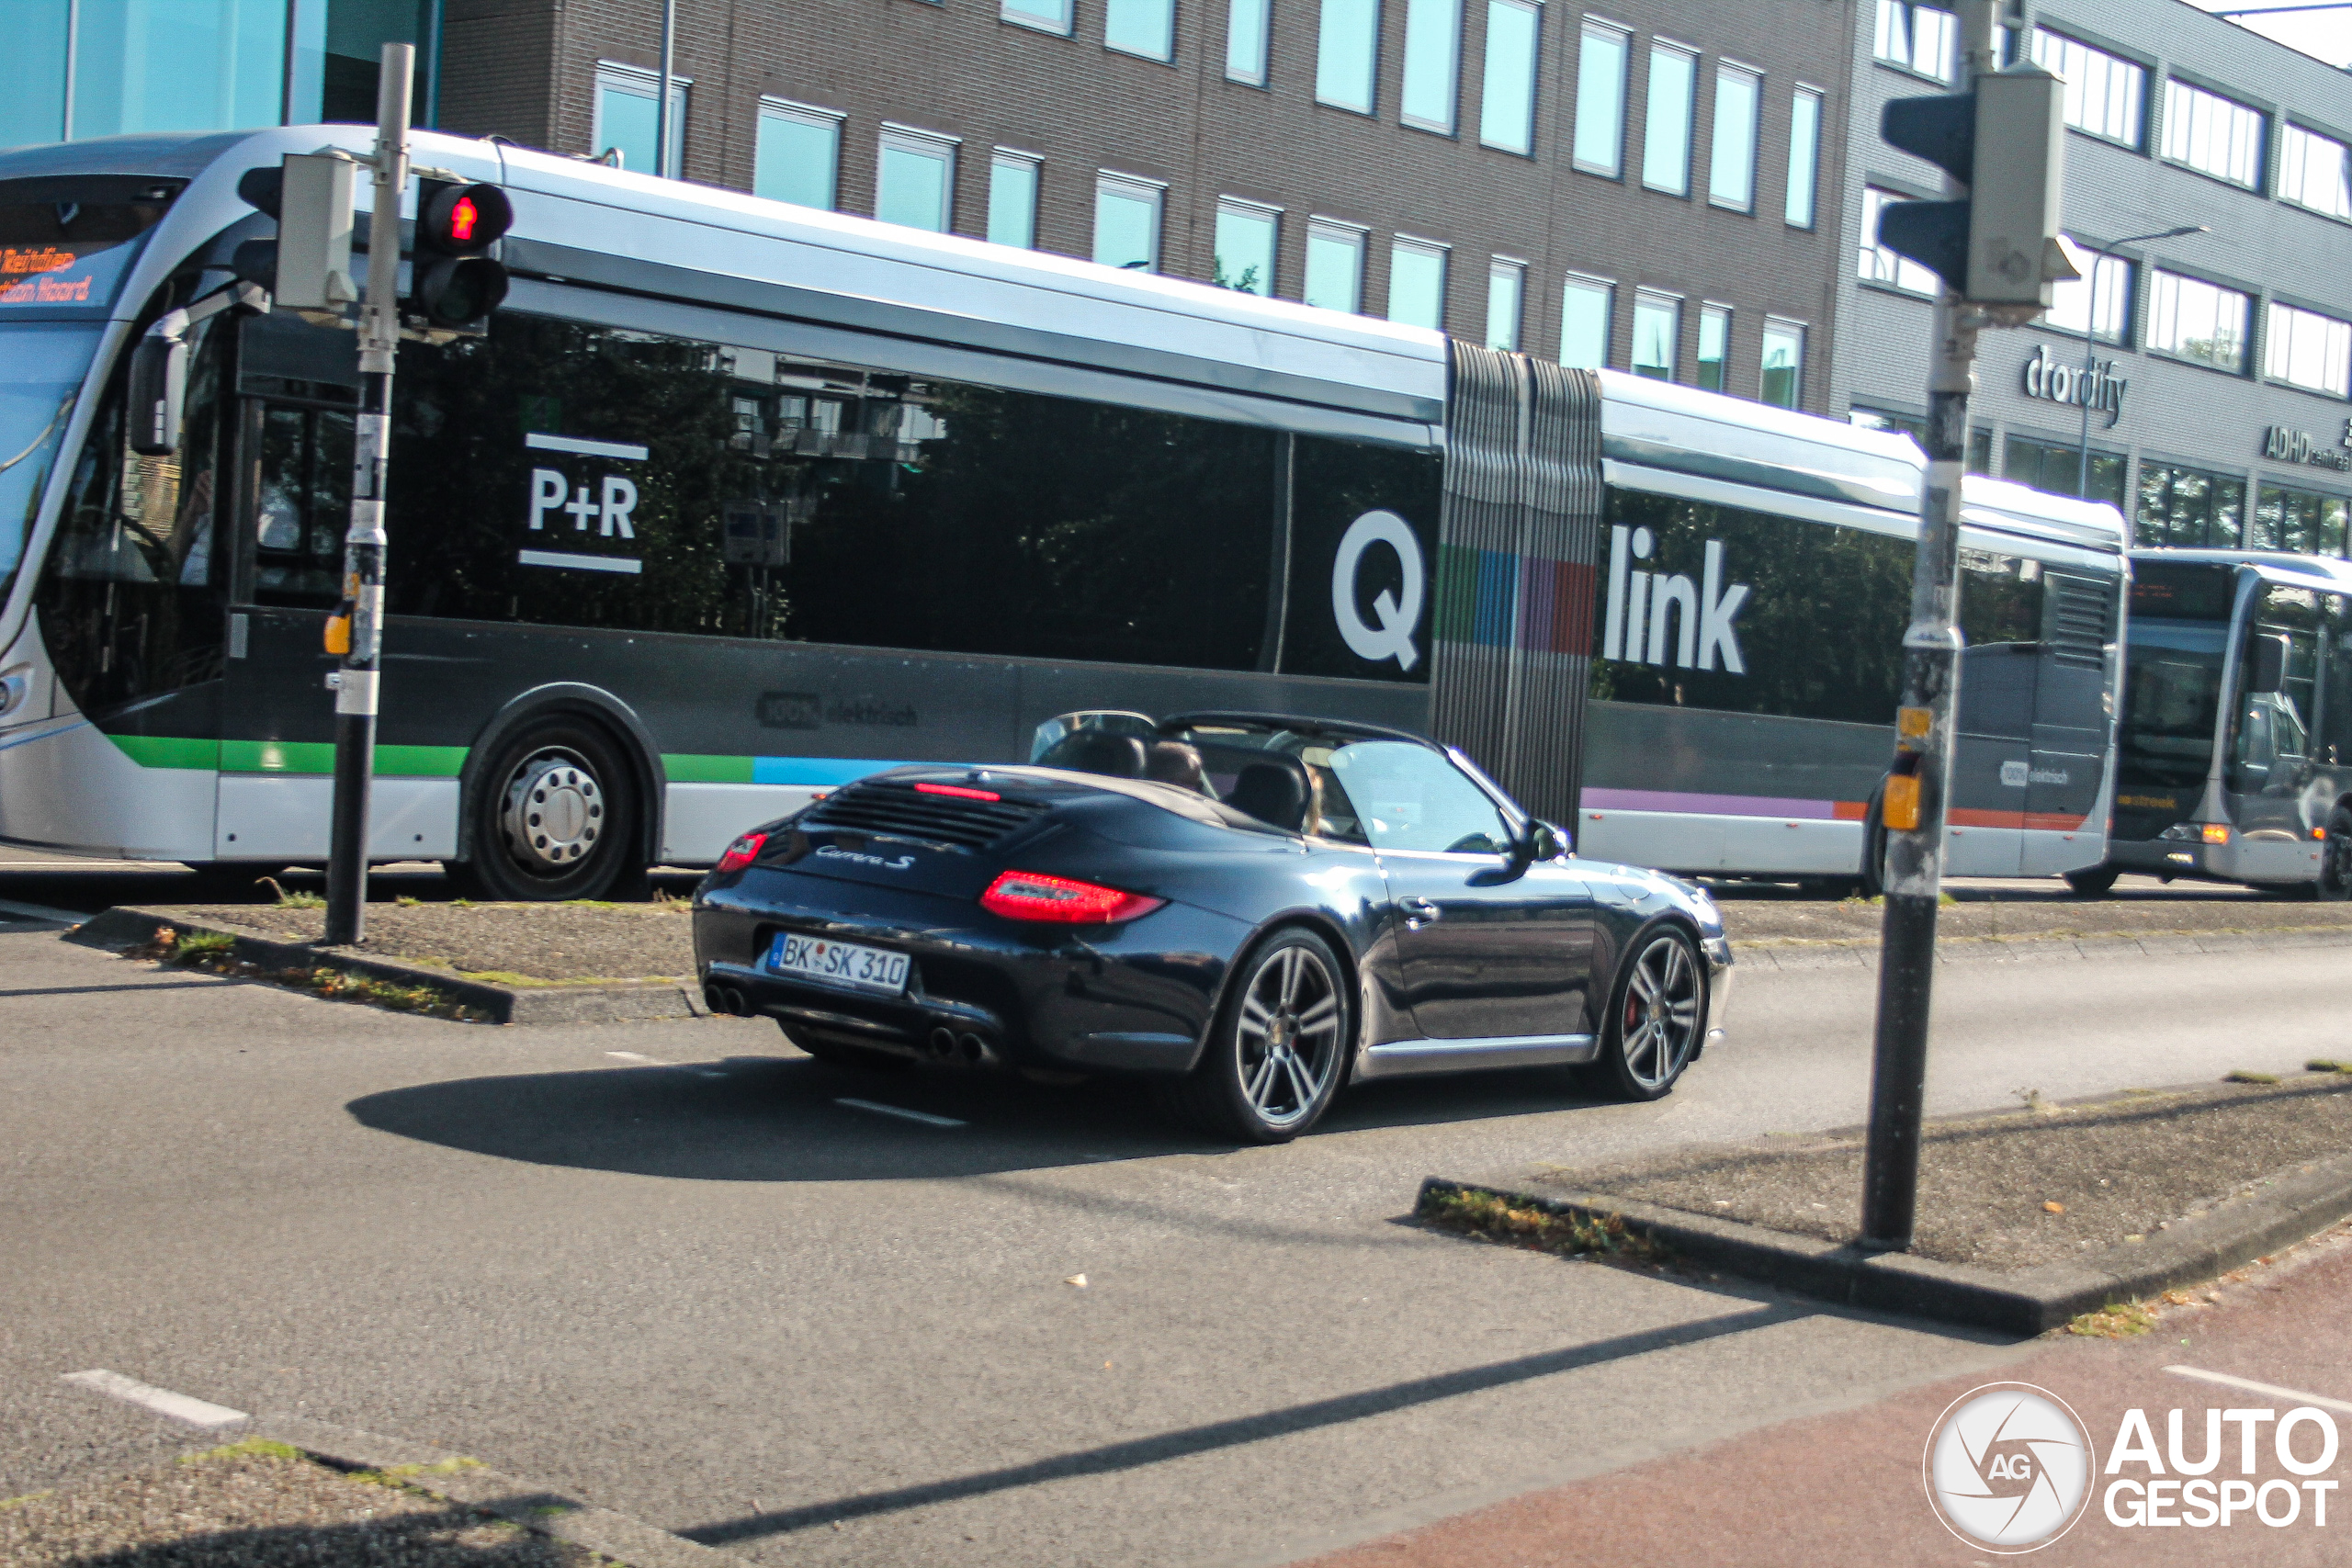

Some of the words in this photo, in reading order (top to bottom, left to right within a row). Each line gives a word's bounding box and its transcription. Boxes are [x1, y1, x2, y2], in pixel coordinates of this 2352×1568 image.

[2026, 344, 2127, 428] chordify
[2264, 425, 2314, 464] ADHD
[529, 468, 639, 539] P+R
[1331, 510, 1426, 671] Q
[1603, 525, 1749, 674] link
[815, 844, 884, 866] Carrera
[884, 855, 916, 869] S
[783, 938, 813, 968] BK
[824, 944, 857, 976] SK
[858, 951, 905, 985] 310
